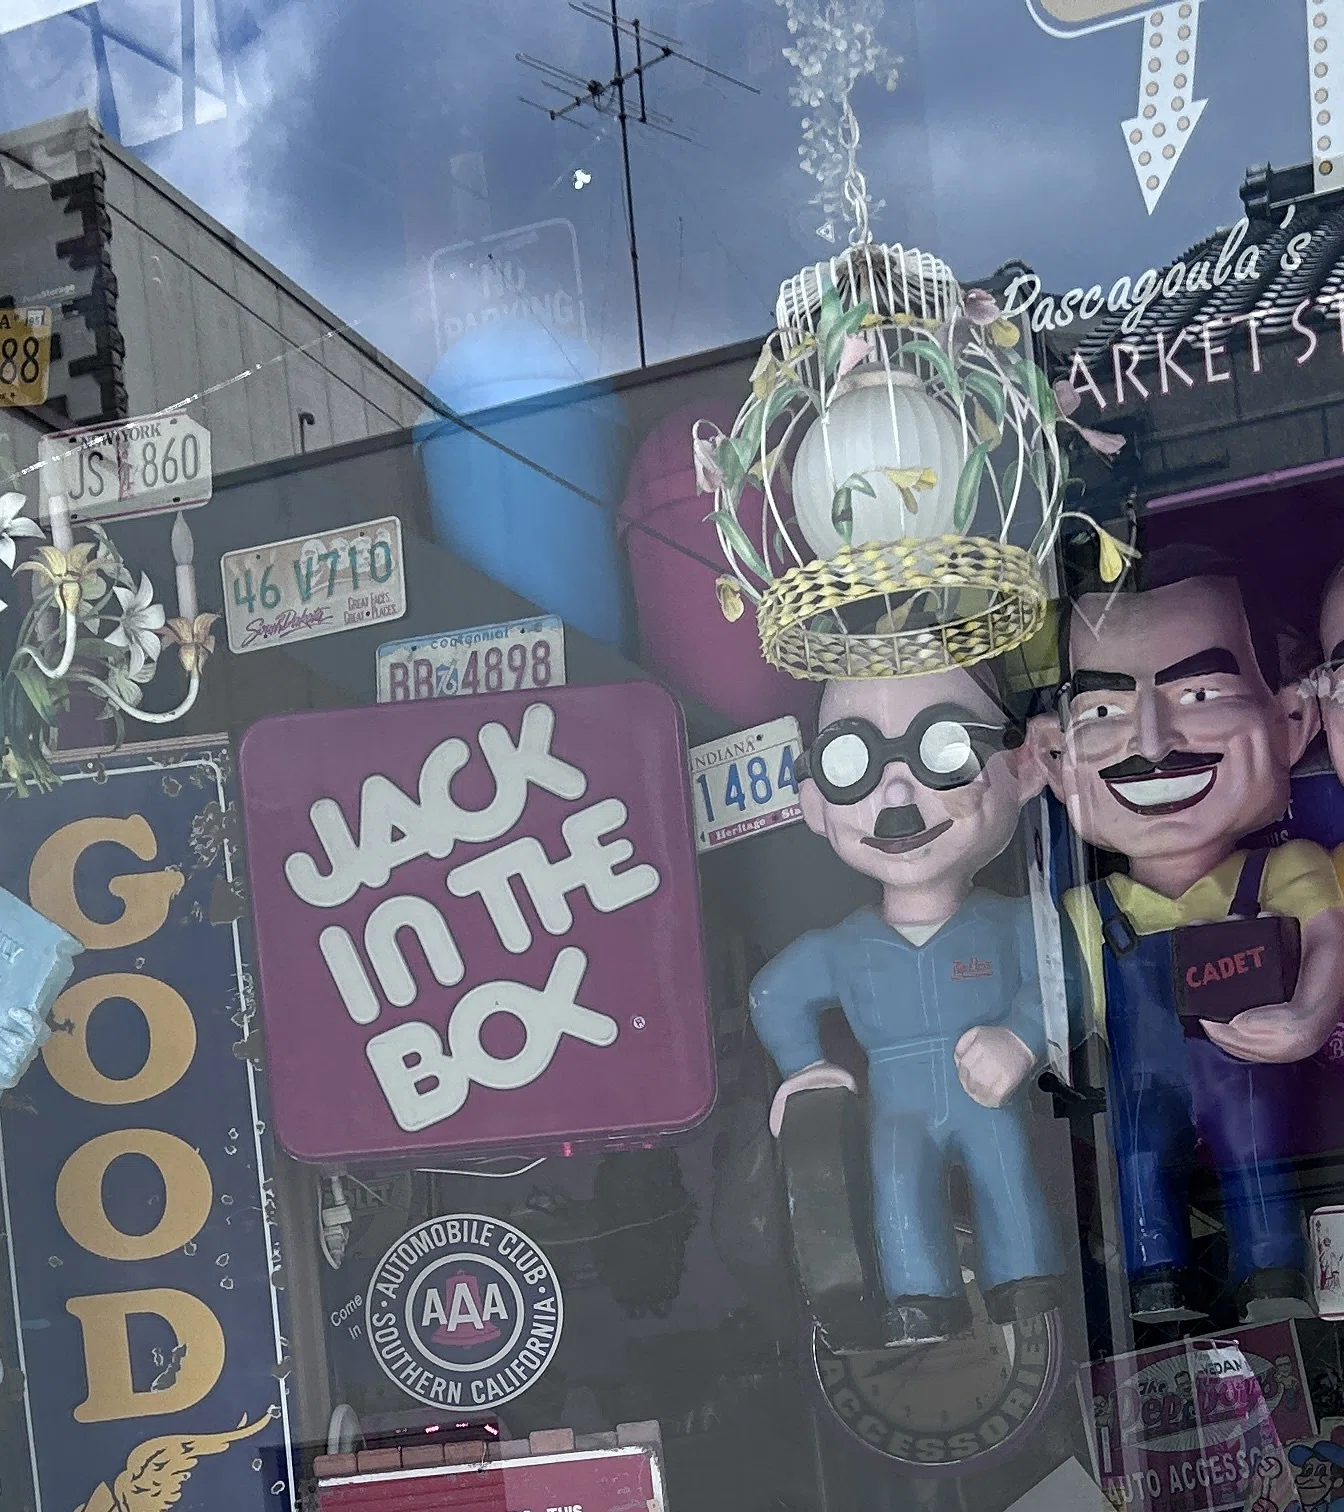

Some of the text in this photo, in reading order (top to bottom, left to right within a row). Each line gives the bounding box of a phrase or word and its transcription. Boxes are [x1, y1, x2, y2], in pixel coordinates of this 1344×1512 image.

[1002, 205, 1313, 333] Pascagoula's
[1068, 303, 1282, 412] ARKET
[122, 423, 161, 440] YORK
[69, 434, 199, 500] JS 860
[234, 567, 281, 613] 46
[461, 641, 552, 695] 4898
[285, 703, 587, 908] JACK
[716, 818, 766, 840] Heritage
[447, 798, 661, 953] THE
[1186, 946, 1265, 988] CADET
[366, 947, 618, 1131] BOX
[375, 1221, 547, 1299] AUTOMOBILE CLUB
[330, 1293, 363, 1328] Come
[421, 1282, 509, 1332] AAA
[371, 1296, 556, 1405] SOUTHERN CALIFORNIA
[1139, 1379, 1167, 1395] The
